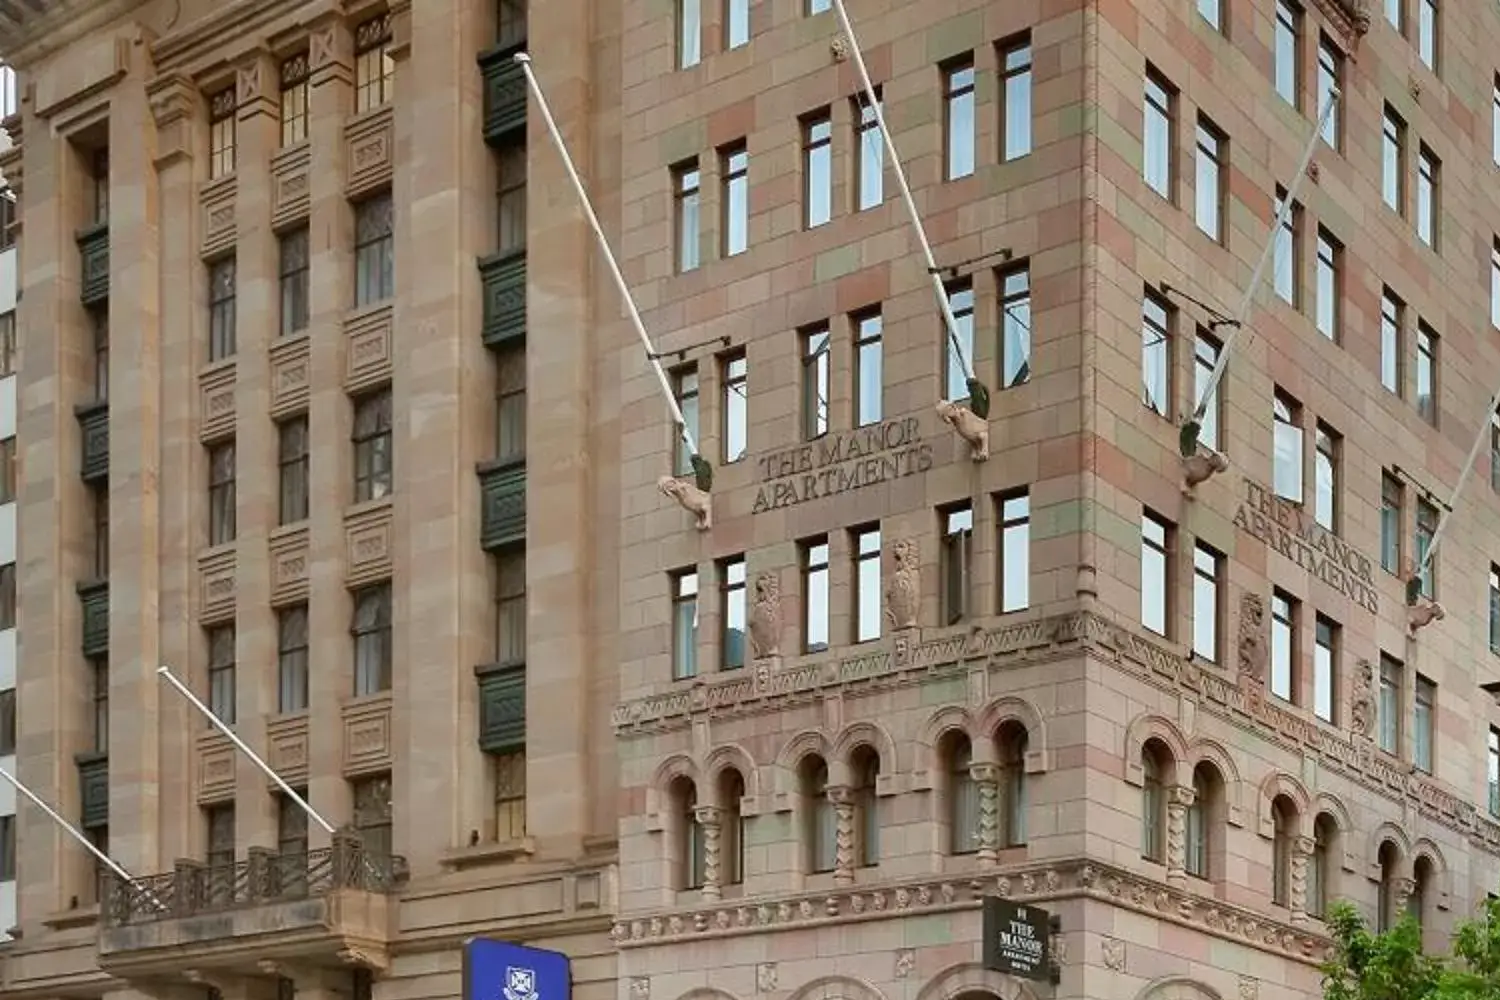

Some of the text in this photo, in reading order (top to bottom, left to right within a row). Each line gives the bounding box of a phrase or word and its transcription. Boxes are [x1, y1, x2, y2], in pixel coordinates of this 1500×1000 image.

[751, 445, 934, 514] APARTMENTS
[759, 416, 922, 483] THE MANOR
[1231, 504, 1379, 616] APARTMENTS
[1242, 477, 1375, 587] THE MANOR
[1000, 931, 1043, 954] MANOR
[1010, 920, 1035, 939] THE
